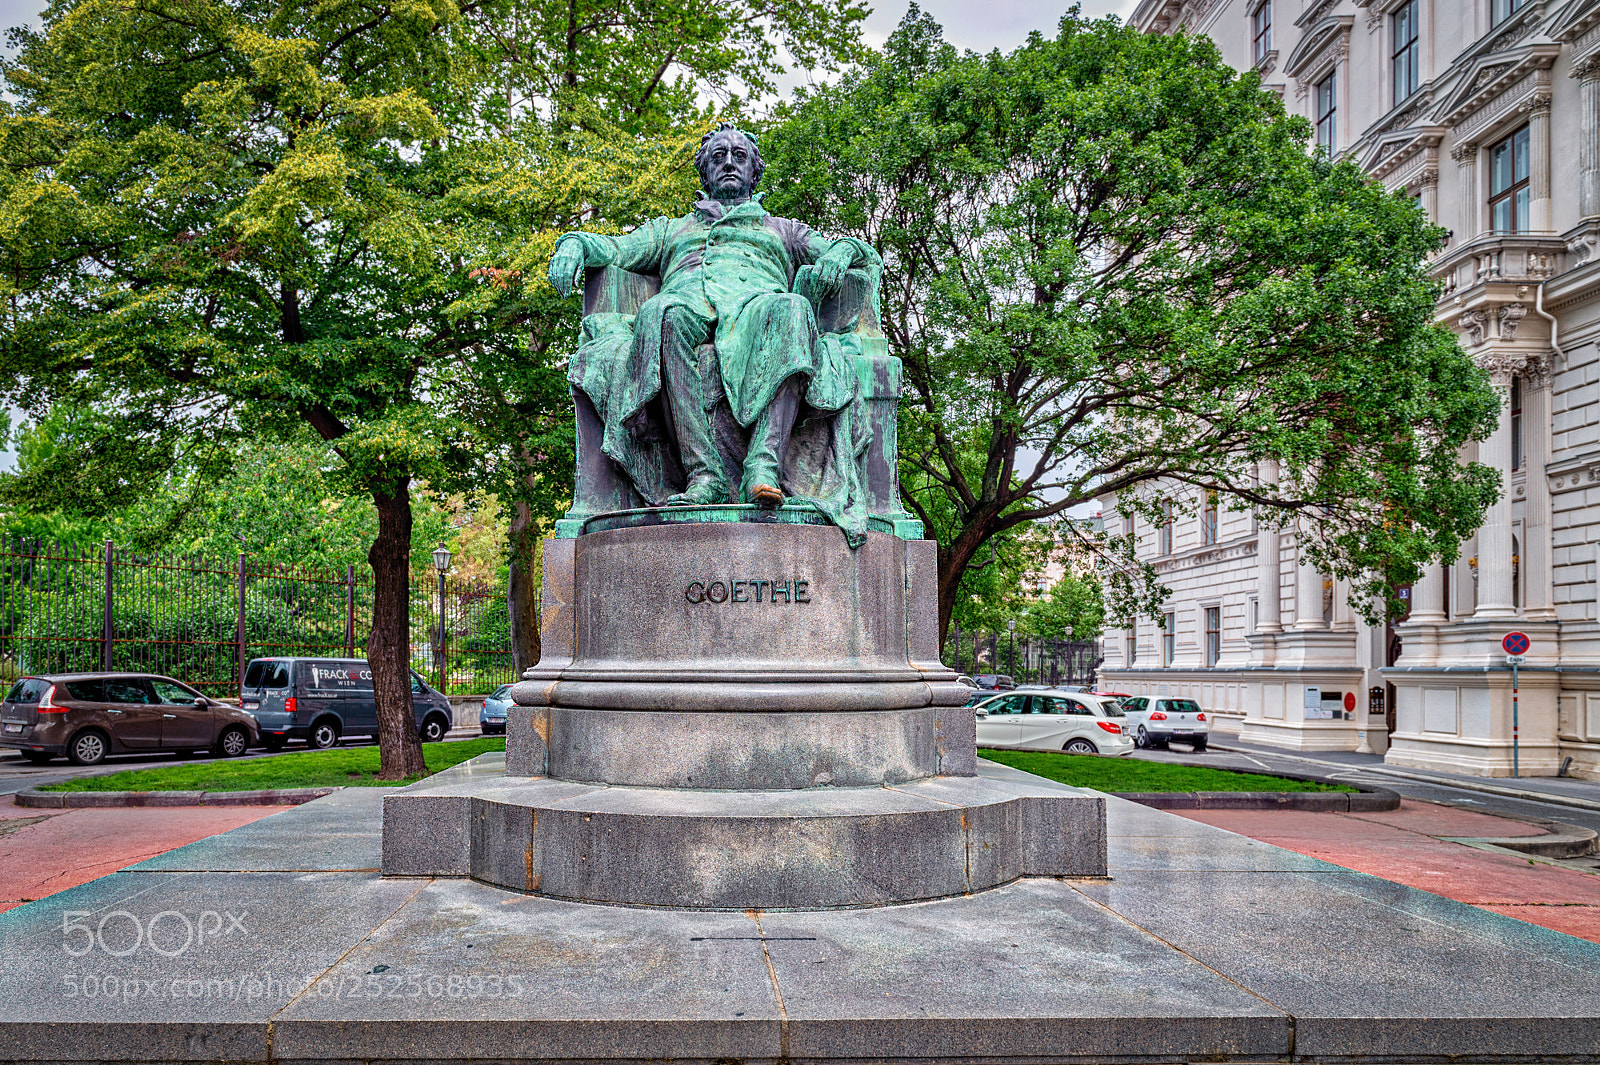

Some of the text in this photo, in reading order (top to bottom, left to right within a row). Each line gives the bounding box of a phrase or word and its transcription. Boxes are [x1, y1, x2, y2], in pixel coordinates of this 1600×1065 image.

[685, 579, 811, 604] GOETHE
[319, 669, 349, 680] FRACK
[350, 670, 359, 680] &
